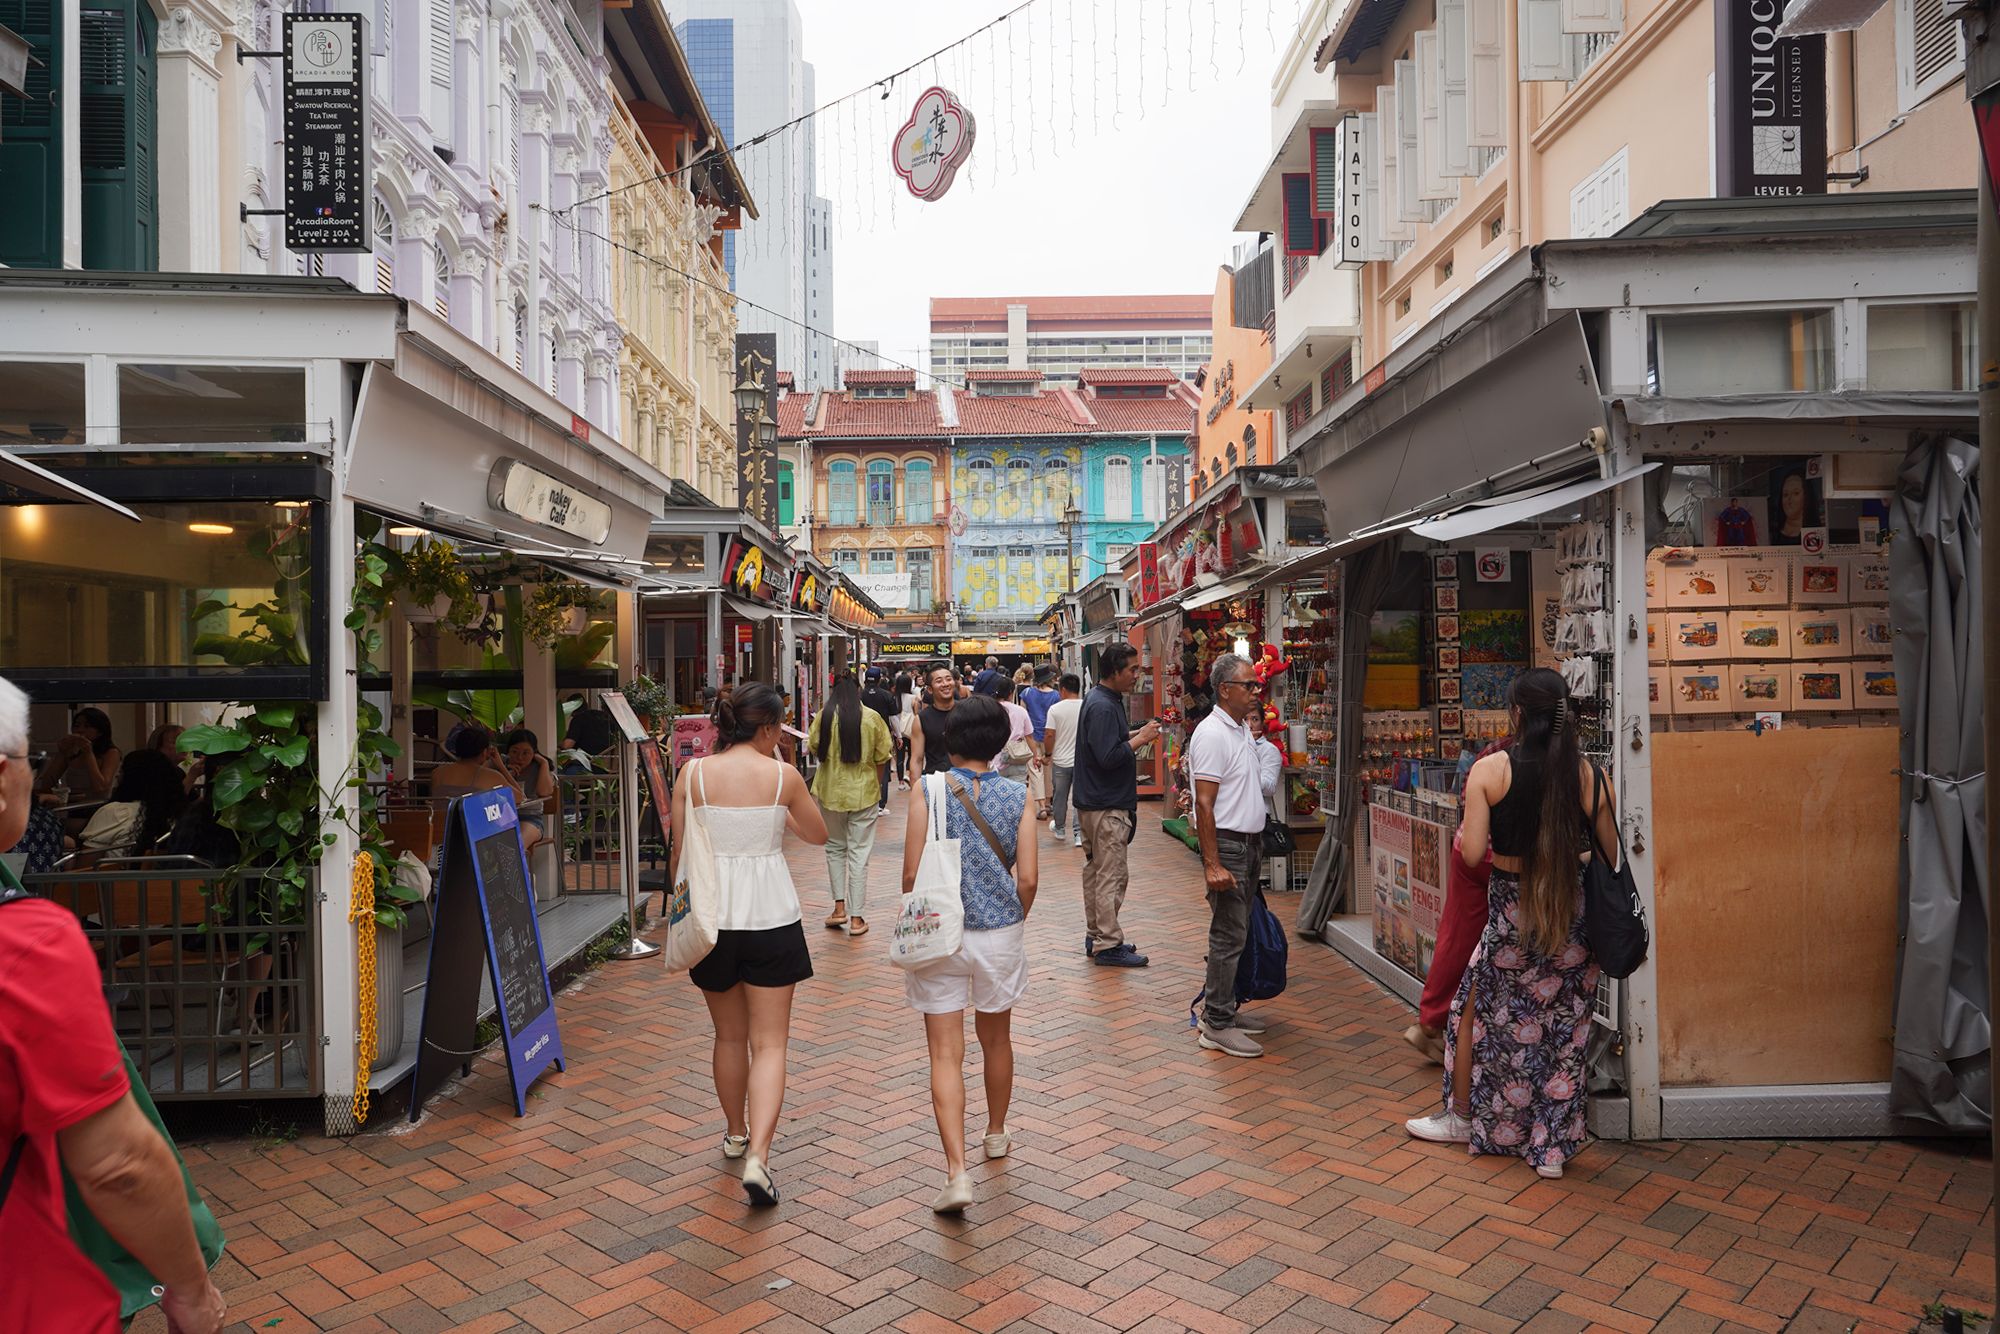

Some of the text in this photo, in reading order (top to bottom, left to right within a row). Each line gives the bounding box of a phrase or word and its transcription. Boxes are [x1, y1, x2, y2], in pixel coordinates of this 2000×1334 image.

[1792, 46, 1801, 118] LICENSED
[1782, 129, 1796, 153] UC
[302, 145, 314, 192] 汕头肠粉
[318, 151, 330, 185] 功夫茶
[335, 133, 346, 203] 潮汕牛肉火锅
[1351, 131, 1360, 248] TATTOO
[1754, 186, 1803, 196] LEVEL 2
[294, 217, 354, 226] ArcadiaRoom
[297, 229, 351, 238] Level 2 10A
[549, 488, 572, 514] nakey
[883, 644, 905, 652] MONEY
[905, 644, 935, 652] CHANGER
[484, 803, 501, 821] VISA
[1378, 809, 1410, 833] FRAMING
[1412, 886, 1433, 911] FENG
